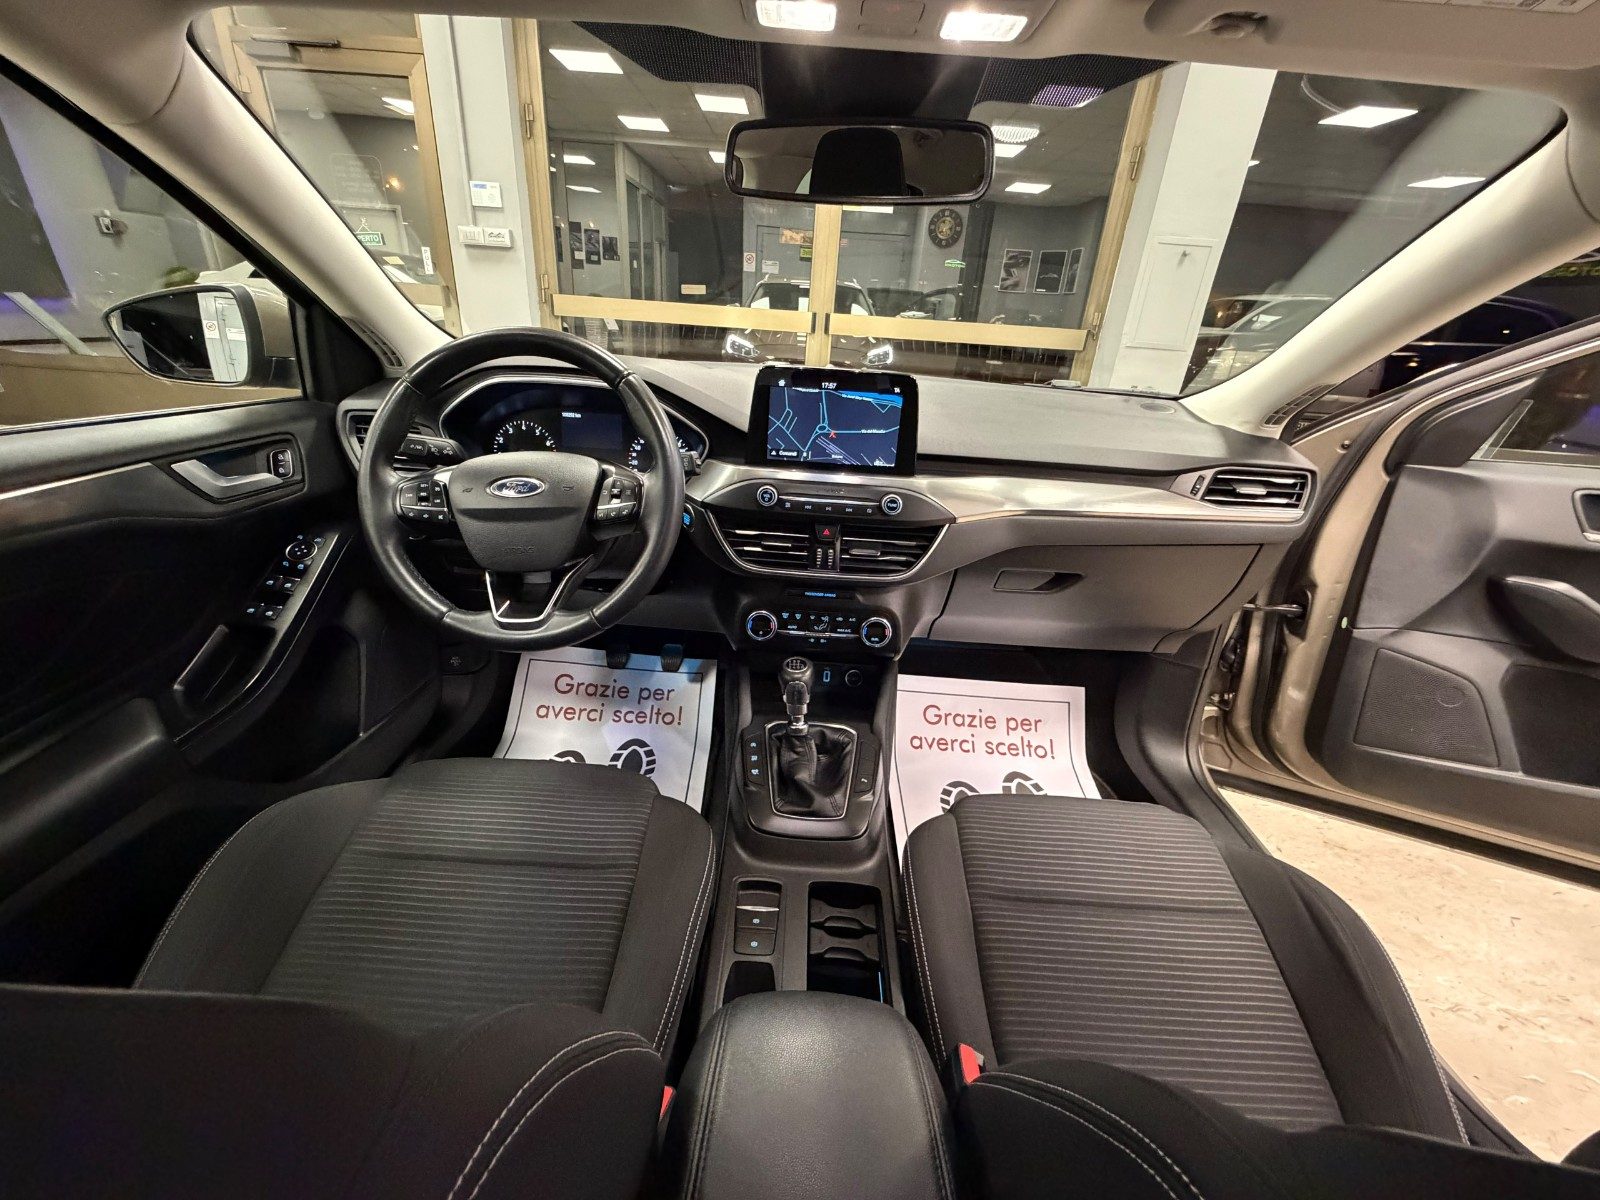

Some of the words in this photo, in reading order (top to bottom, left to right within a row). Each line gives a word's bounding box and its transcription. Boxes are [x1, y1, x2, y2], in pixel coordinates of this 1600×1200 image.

[502, 481, 530, 494] Ford
[553, 673, 630, 699] Grazie
[637, 686, 676, 704] per
[535, 703, 605, 722] averci
[611, 704, 683, 726] scelto!
[922, 704, 998, 730] Grazie
[1005, 716, 1043, 736] per
[909, 733, 976, 754] averci
[984, 736, 1056, 760] scelto!
